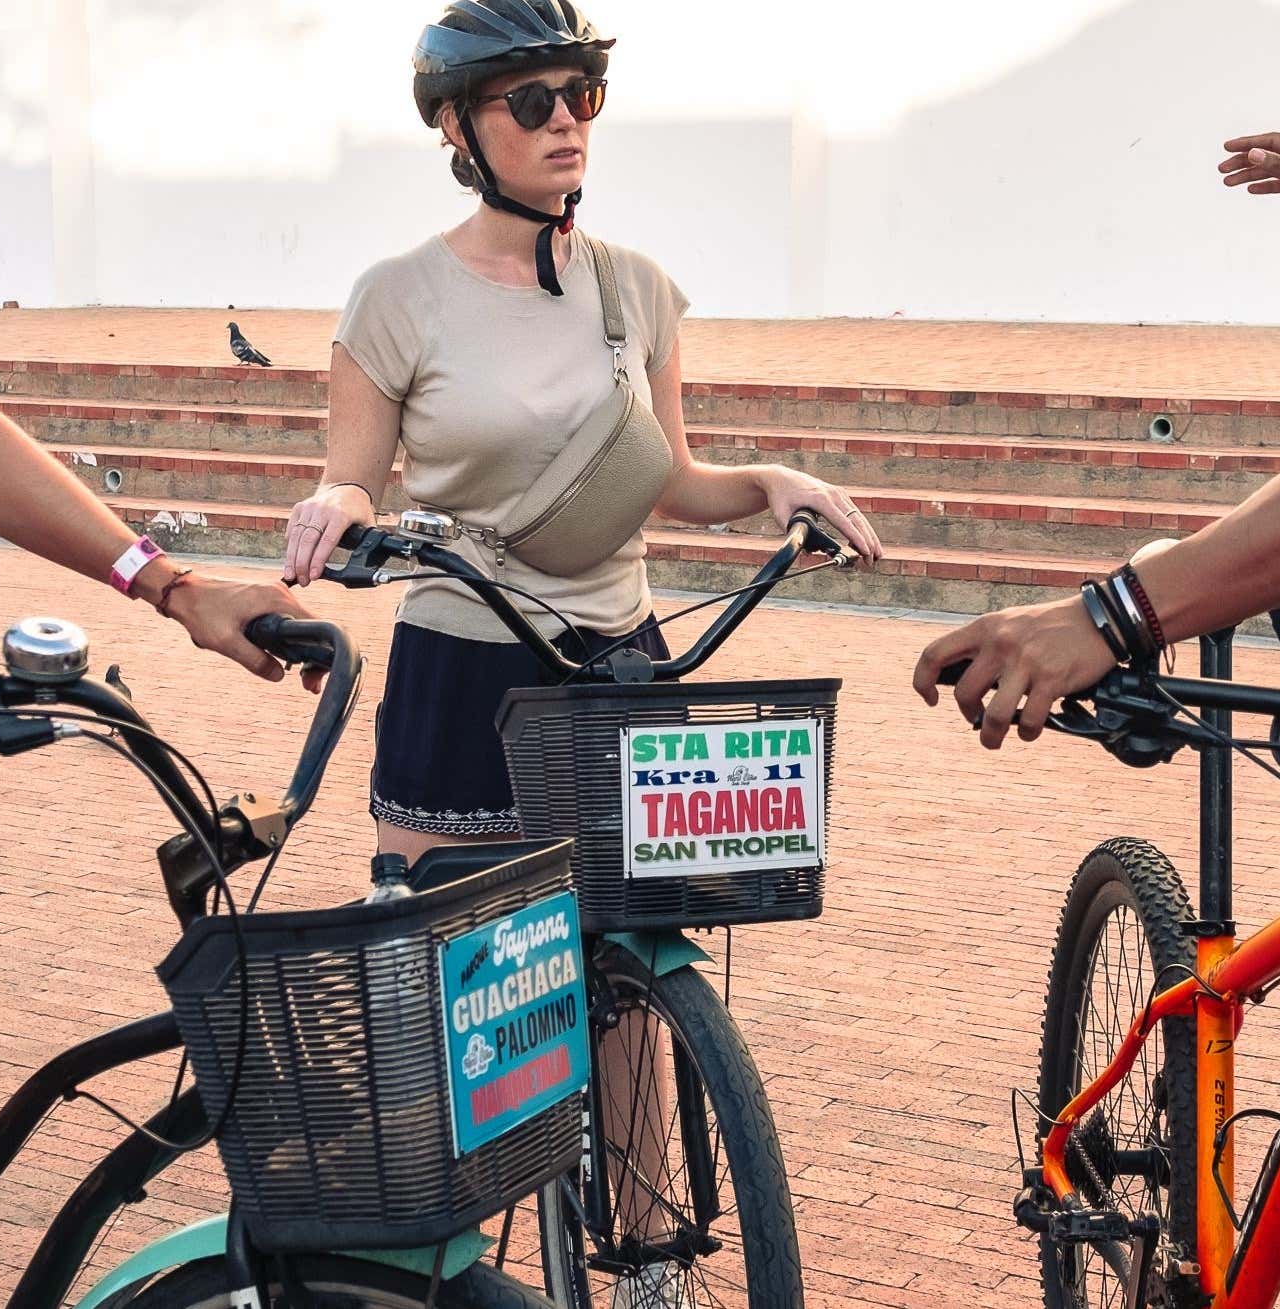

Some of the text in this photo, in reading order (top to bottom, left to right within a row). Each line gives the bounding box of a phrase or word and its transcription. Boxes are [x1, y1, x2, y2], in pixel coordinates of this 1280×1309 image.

[631, 729, 813, 763] STA RITA
[631, 768, 720, 787] Kra
[763, 762, 806, 781] 11
[641, 786, 807, 838] TAGANGA
[634, 834, 816, 862] SAN TROPEL
[460, 911, 570, 988] PARQUE Tayrona
[452, 948, 578, 1034] GUACHACA
[494, 992, 577, 1066] PALOMINO
